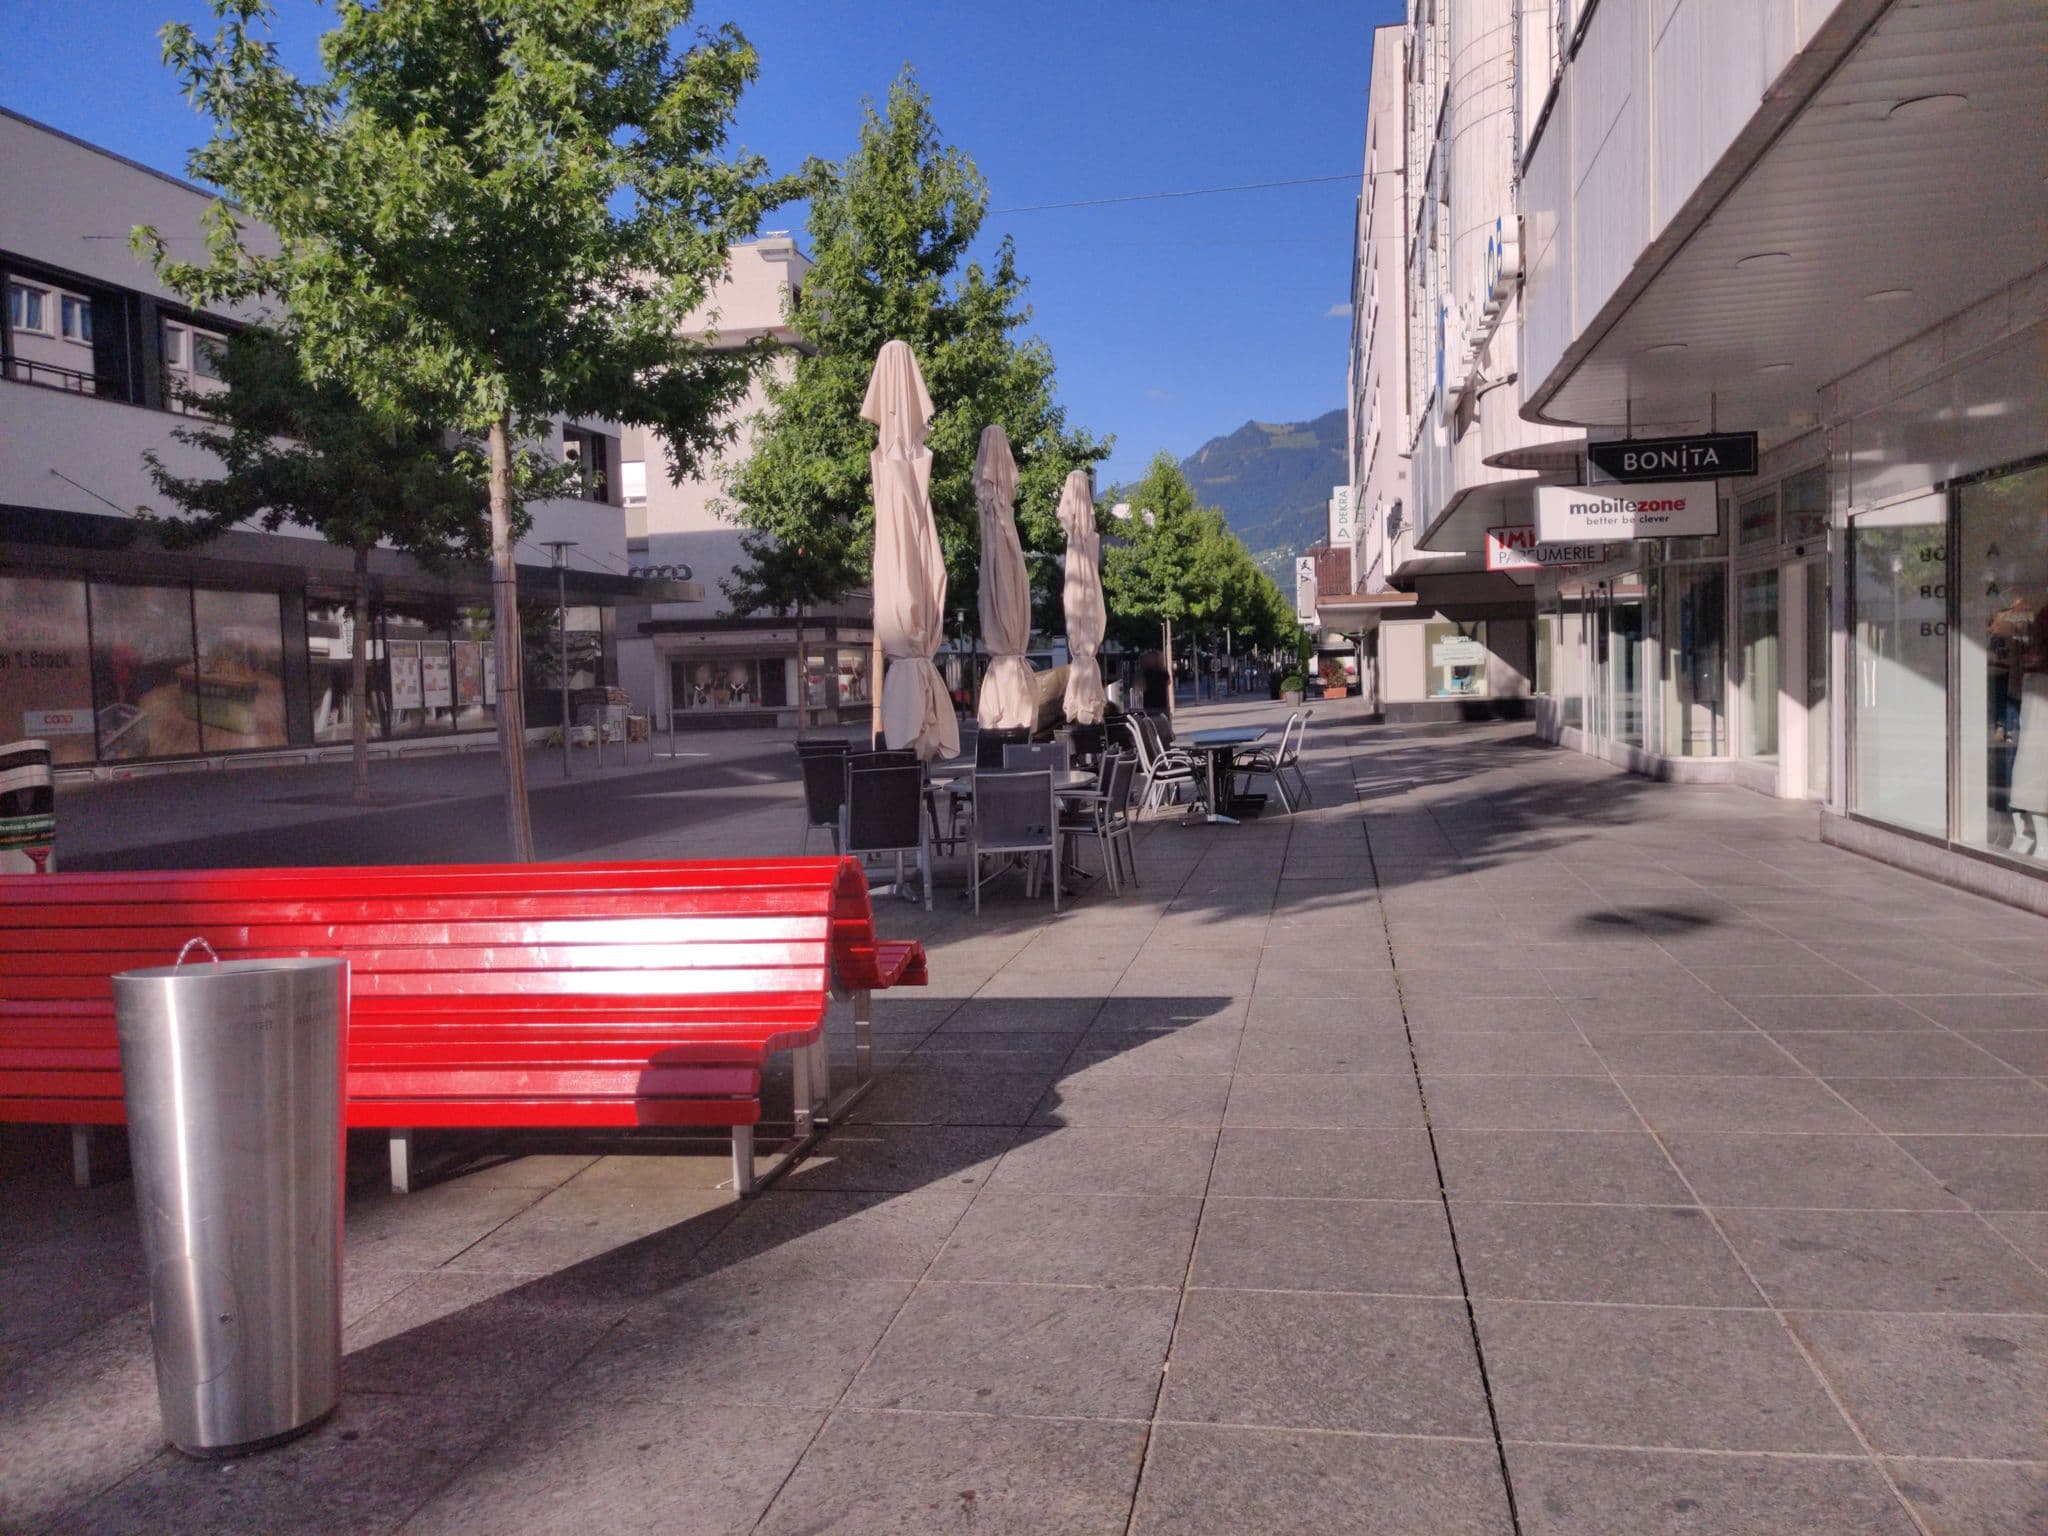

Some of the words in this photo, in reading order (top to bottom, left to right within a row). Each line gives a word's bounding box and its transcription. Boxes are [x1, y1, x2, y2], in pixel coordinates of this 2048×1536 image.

[1623, 444, 1719, 473] BONITA
[1338, 490, 1348, 524] DEKRA
[1569, 497, 1687, 515] mobilezone
[1586, 516, 1618, 526] better
[1622, 515, 1636, 525] be
[1639, 514, 1669, 524] clever
